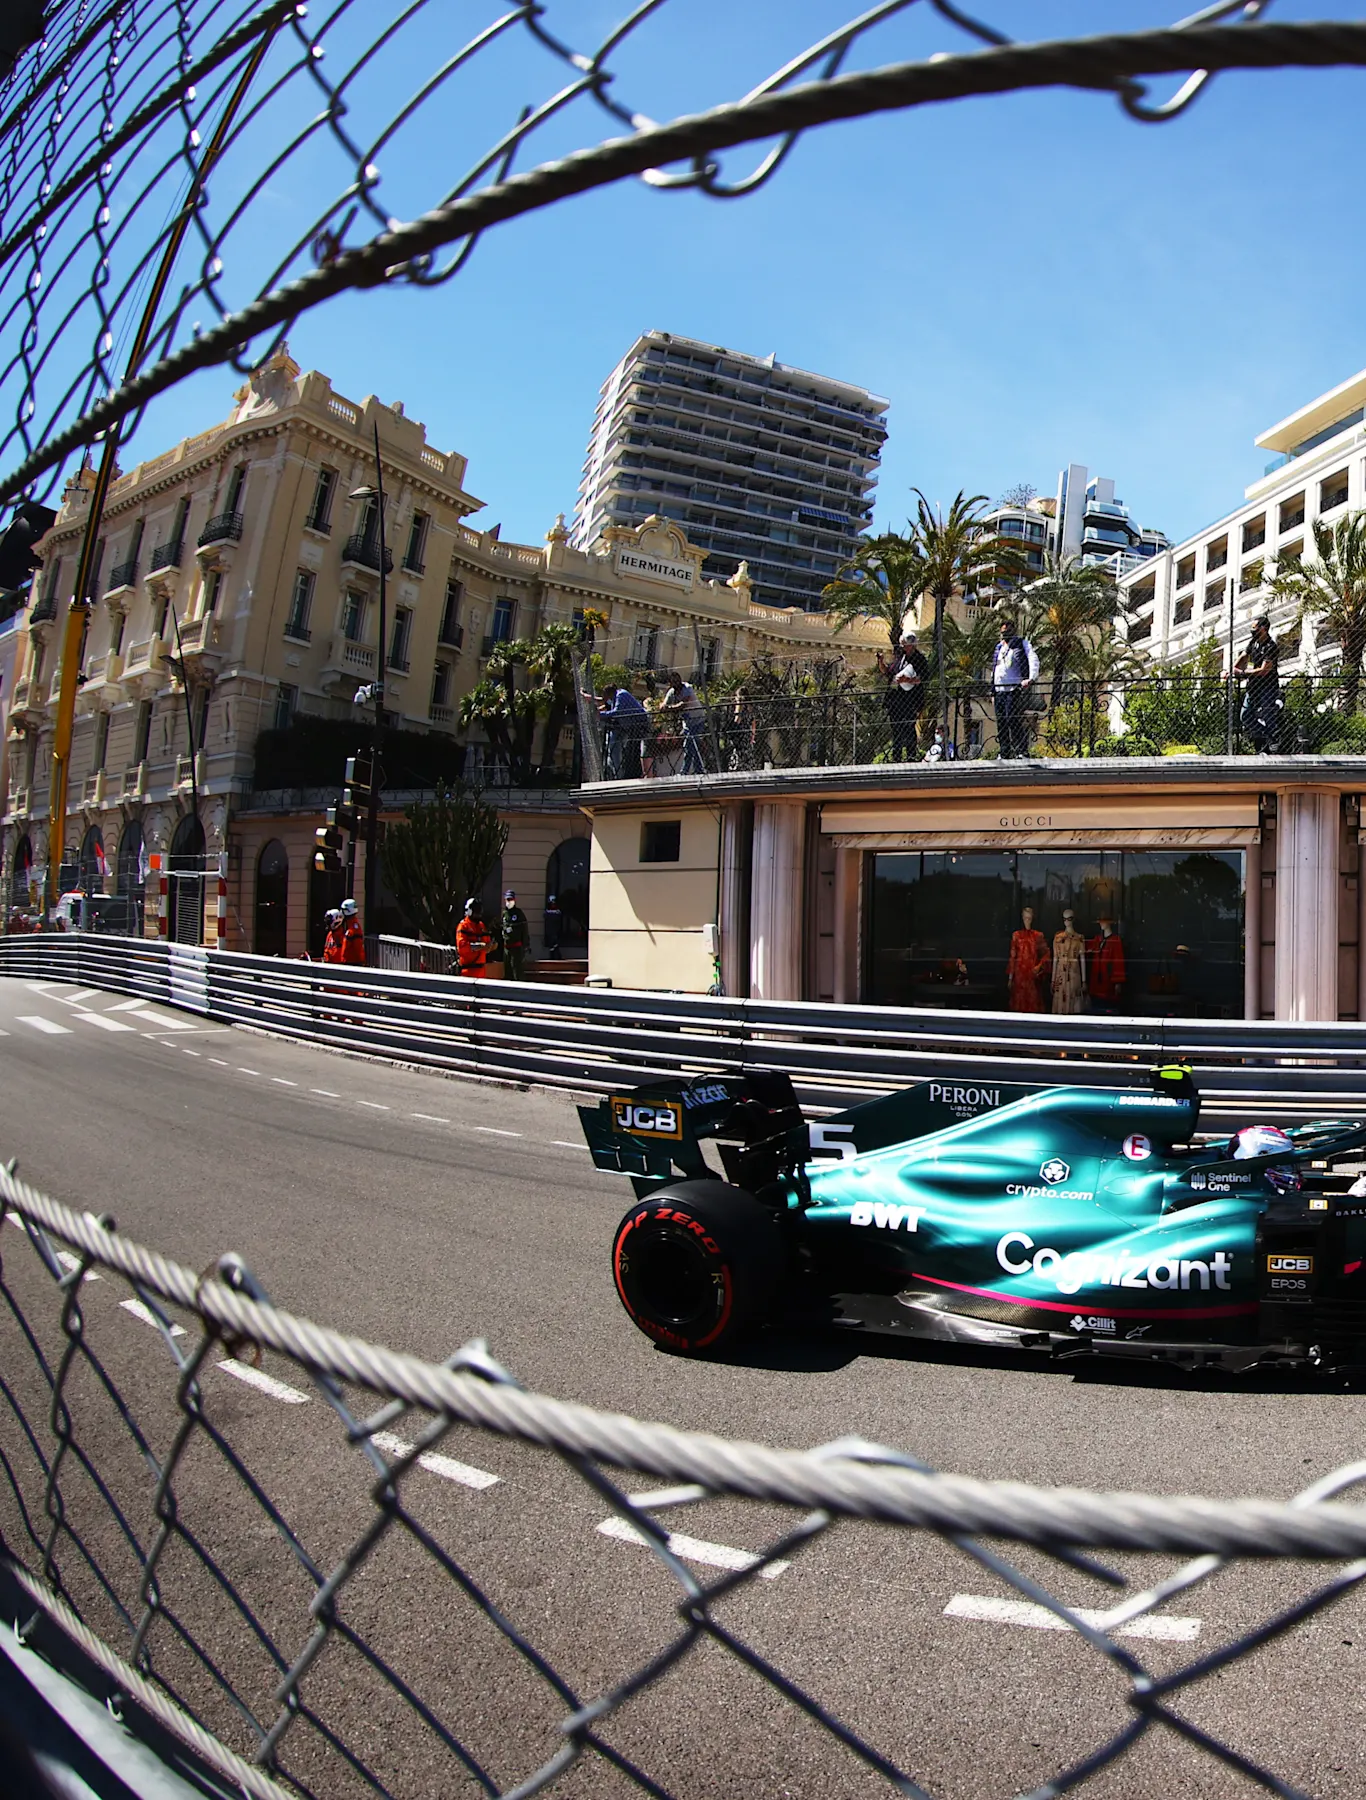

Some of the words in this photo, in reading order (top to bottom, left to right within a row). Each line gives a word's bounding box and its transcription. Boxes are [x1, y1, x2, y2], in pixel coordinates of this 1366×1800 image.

[620, 554, 692, 581] HERMITAGE
[999, 816, 1052, 827] GUCCI
[929, 1083, 1000, 1106] PERONI
[1119, 1096, 1191, 1107] BOMBARDIER
[617, 1104, 677, 1132] JCB
[809, 1122, 858, 1161] 5
[1131, 1136, 1145, 1157] E
[1208, 1172, 1252, 1183] Sentinel
[1208, 1182, 1231, 1192] One
[1006, 1183, 1094, 1200] crypto.com
[850, 1201, 927, 1233] BWT
[635, 1211, 648, 1229] P
[654, 1207, 721, 1254] ZERO
[996, 1231, 1232, 1295] Cognizant
[1271, 1258, 1310, 1270] JCB
[1271, 1278, 1307, 1290] EPOS
[1087, 1316, 1117, 1329] Cillit
